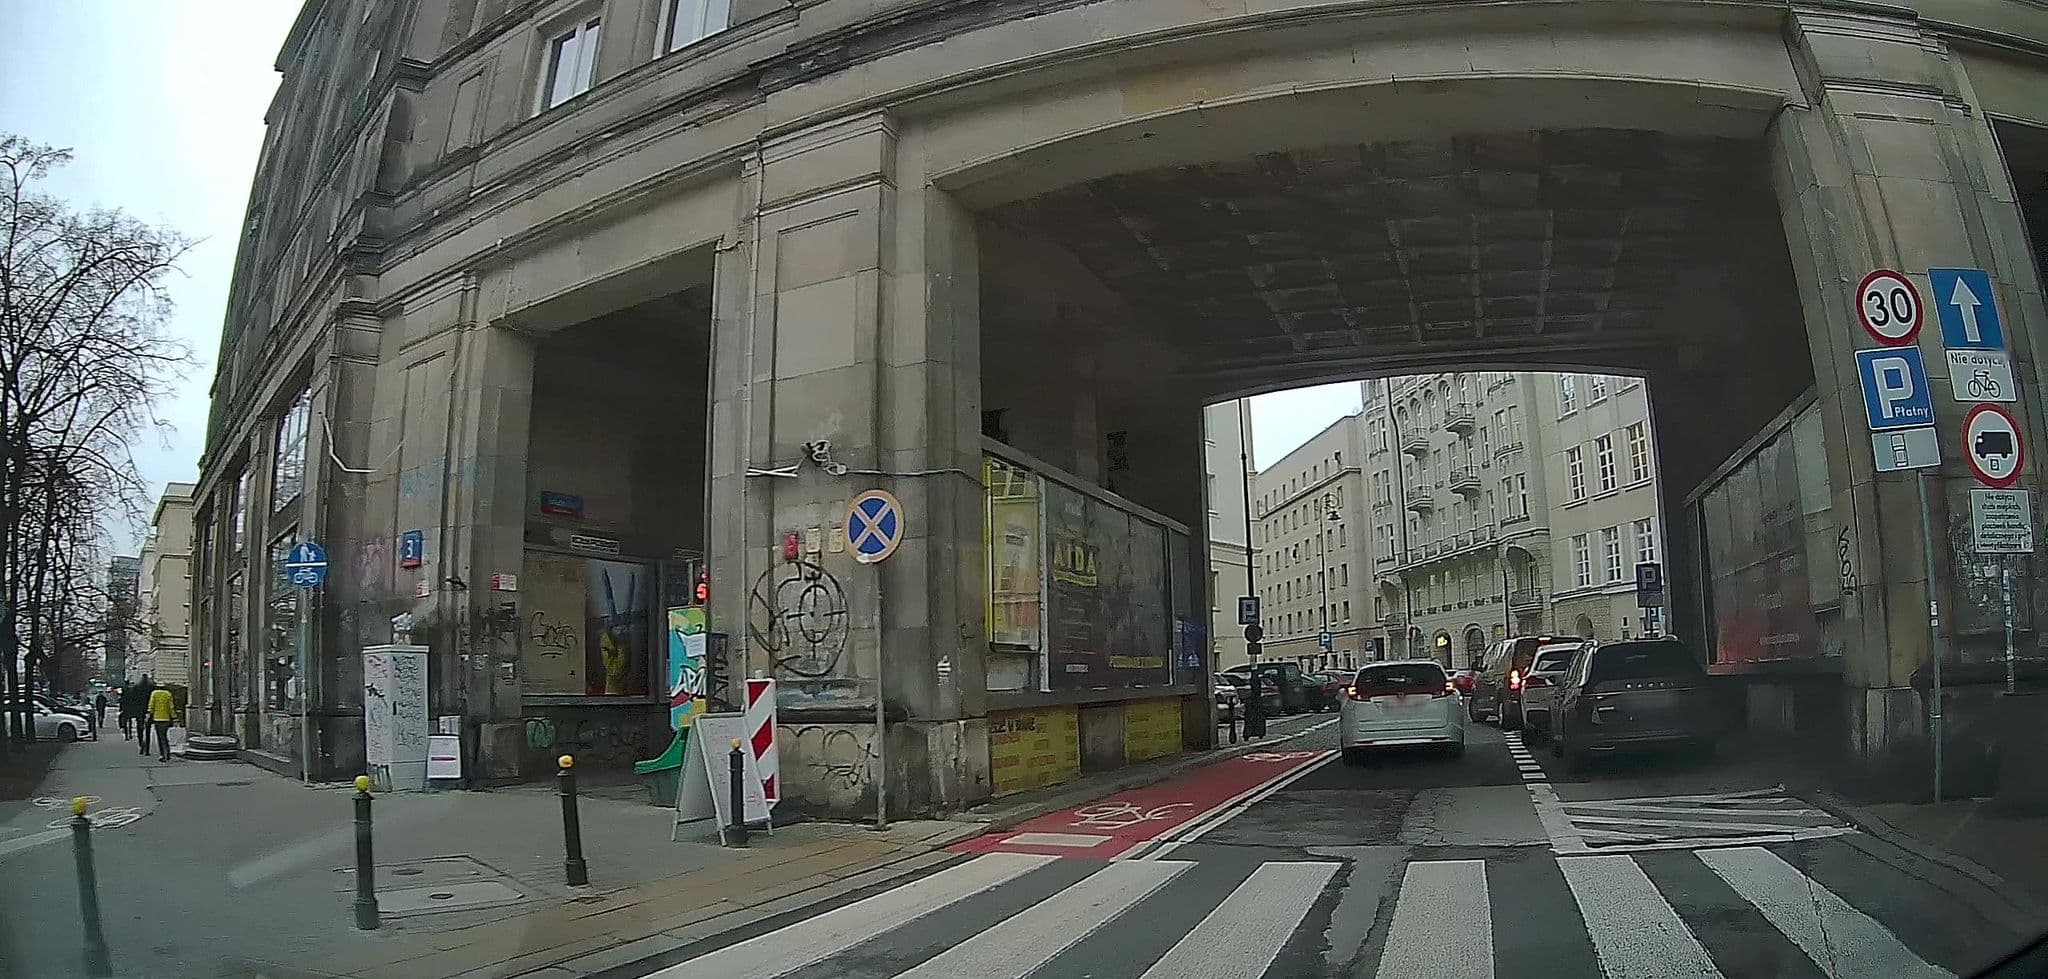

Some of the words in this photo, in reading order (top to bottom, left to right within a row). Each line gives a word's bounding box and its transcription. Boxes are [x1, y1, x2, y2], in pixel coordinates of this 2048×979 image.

[1867, 287, 1913, 327] 30
[1950, 352, 1968, 364] Nie
[1871, 356, 1914, 419] P
[1894, 406, 1930, 419] Płatny
[406, 539, 414, 558] 3
[1642, 567, 1657, 590] P
[1321, 633, 1330, 648] P
